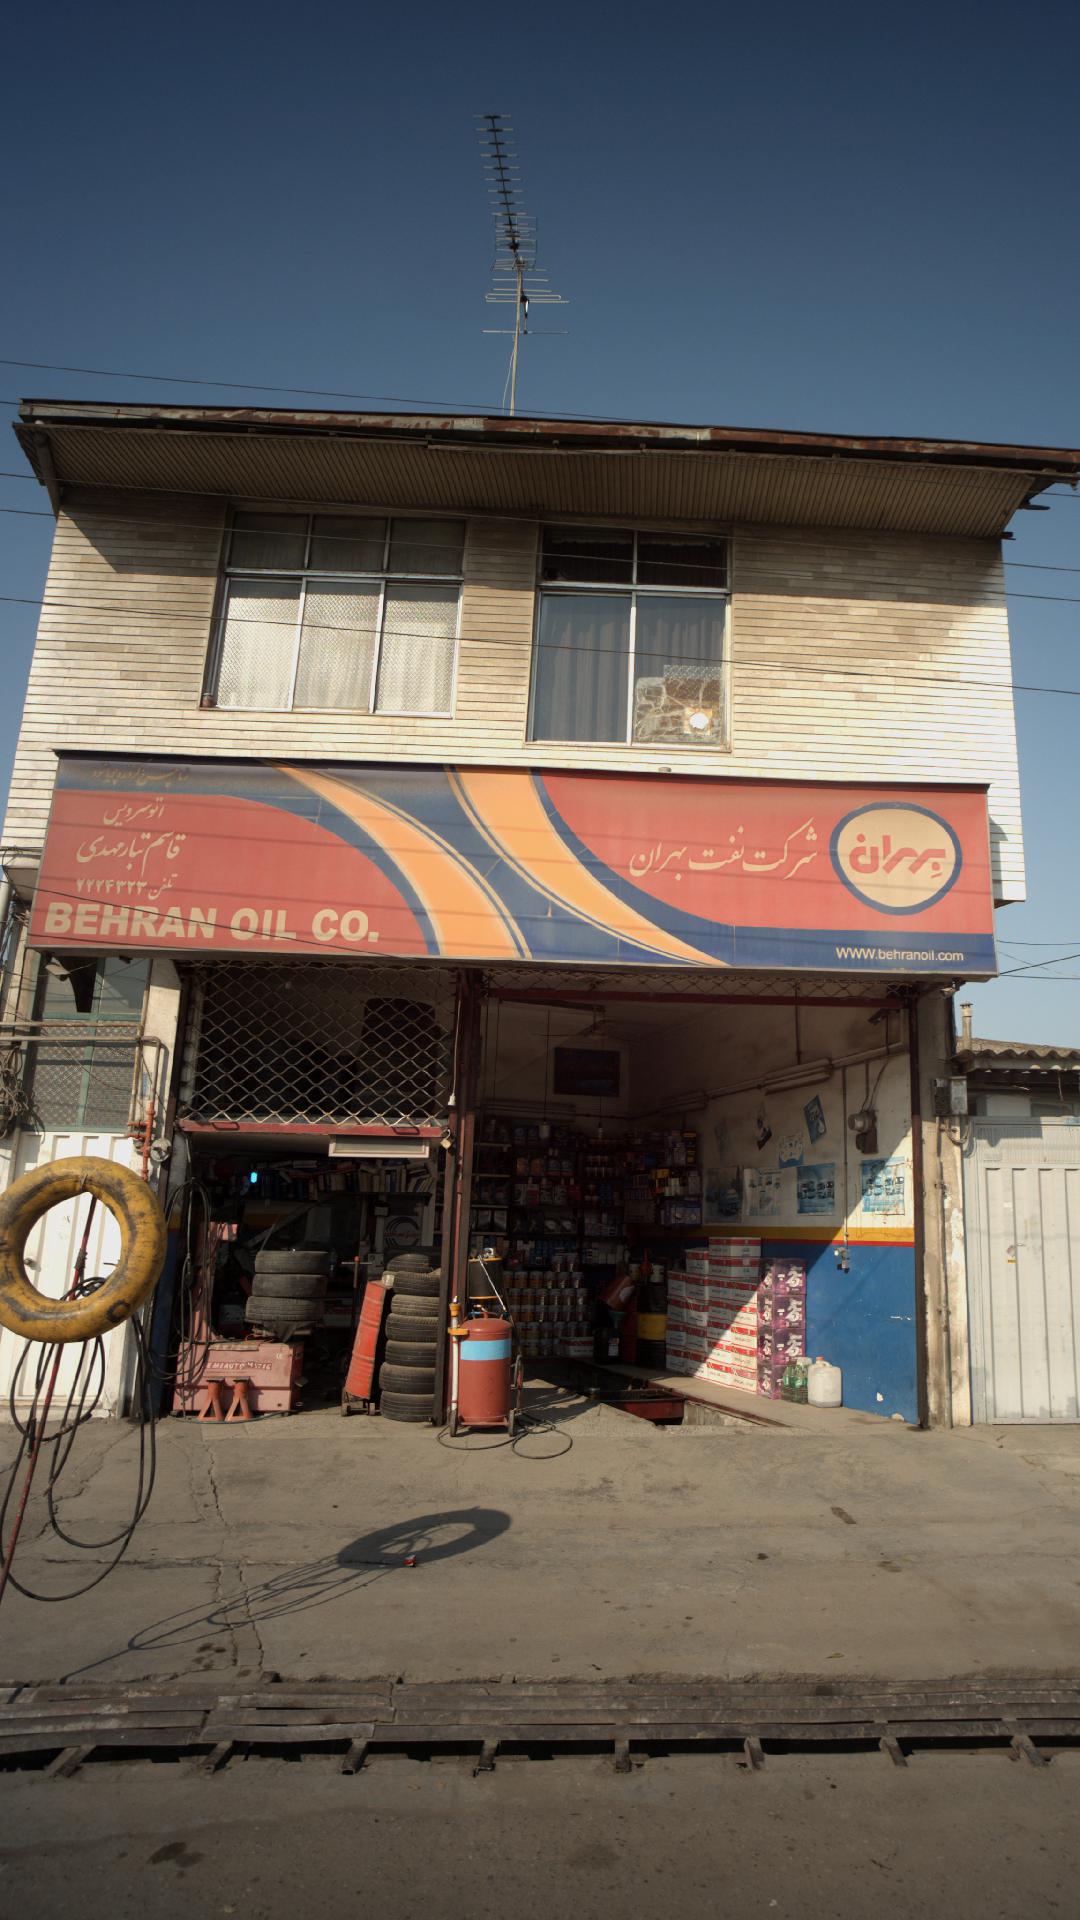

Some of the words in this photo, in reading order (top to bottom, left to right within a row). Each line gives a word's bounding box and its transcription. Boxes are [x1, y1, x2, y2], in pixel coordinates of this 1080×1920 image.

[629, 842, 688, 881] بهران
[688, 825, 745, 871] نفت
[742, 817, 818, 880] شرکت
[148, 873, 178, 900] تلفن
[44, 902, 216, 939] BEHRAN
[230, 907, 297, 940] OIL
[311, 908, 380, 943] CO.
[205, 1361, 246, 1371] EMIAUTO
